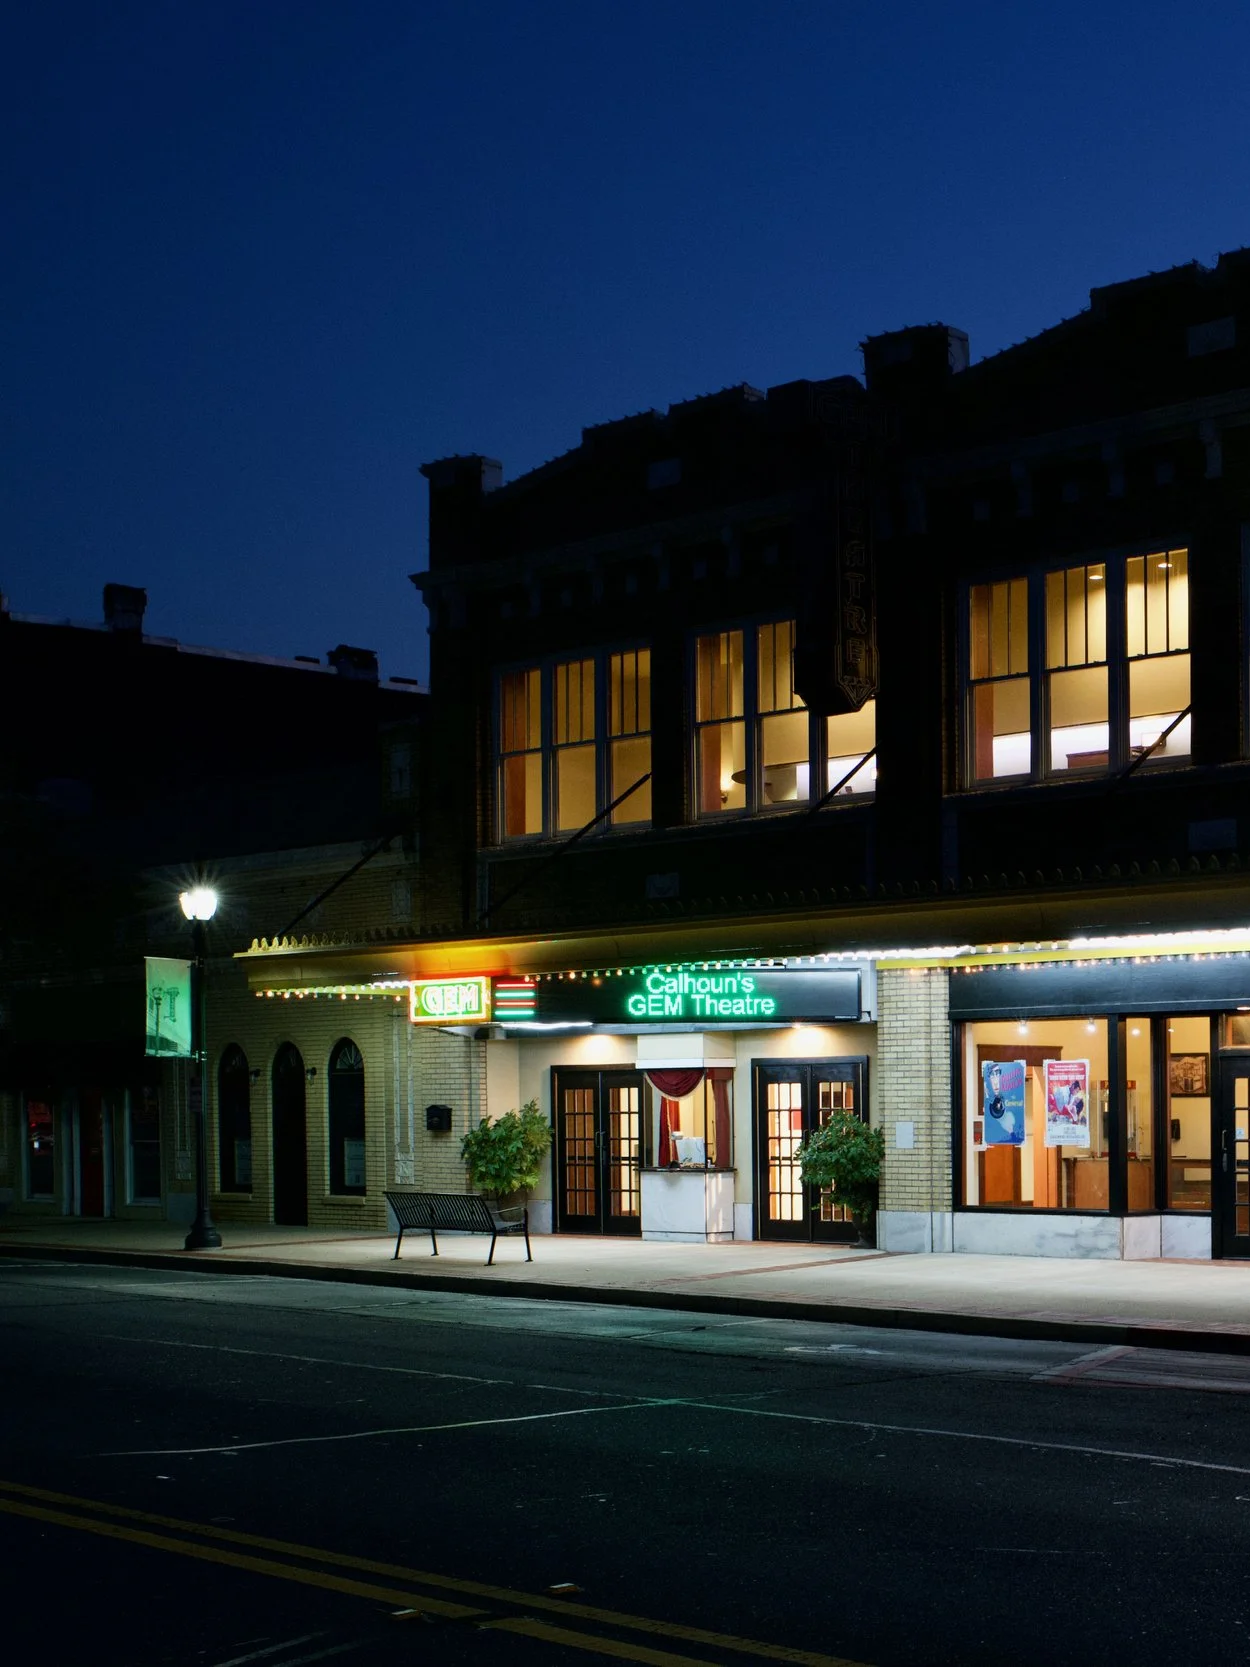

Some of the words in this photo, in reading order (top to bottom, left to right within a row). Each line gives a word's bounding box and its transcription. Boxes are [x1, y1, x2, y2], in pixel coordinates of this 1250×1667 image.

[646, 972, 755, 994] Calhoun's
[421, 984, 479, 1014] GEM
[628, 995, 682, 1016] GEM
[691, 994, 775, 1015] Theatre
